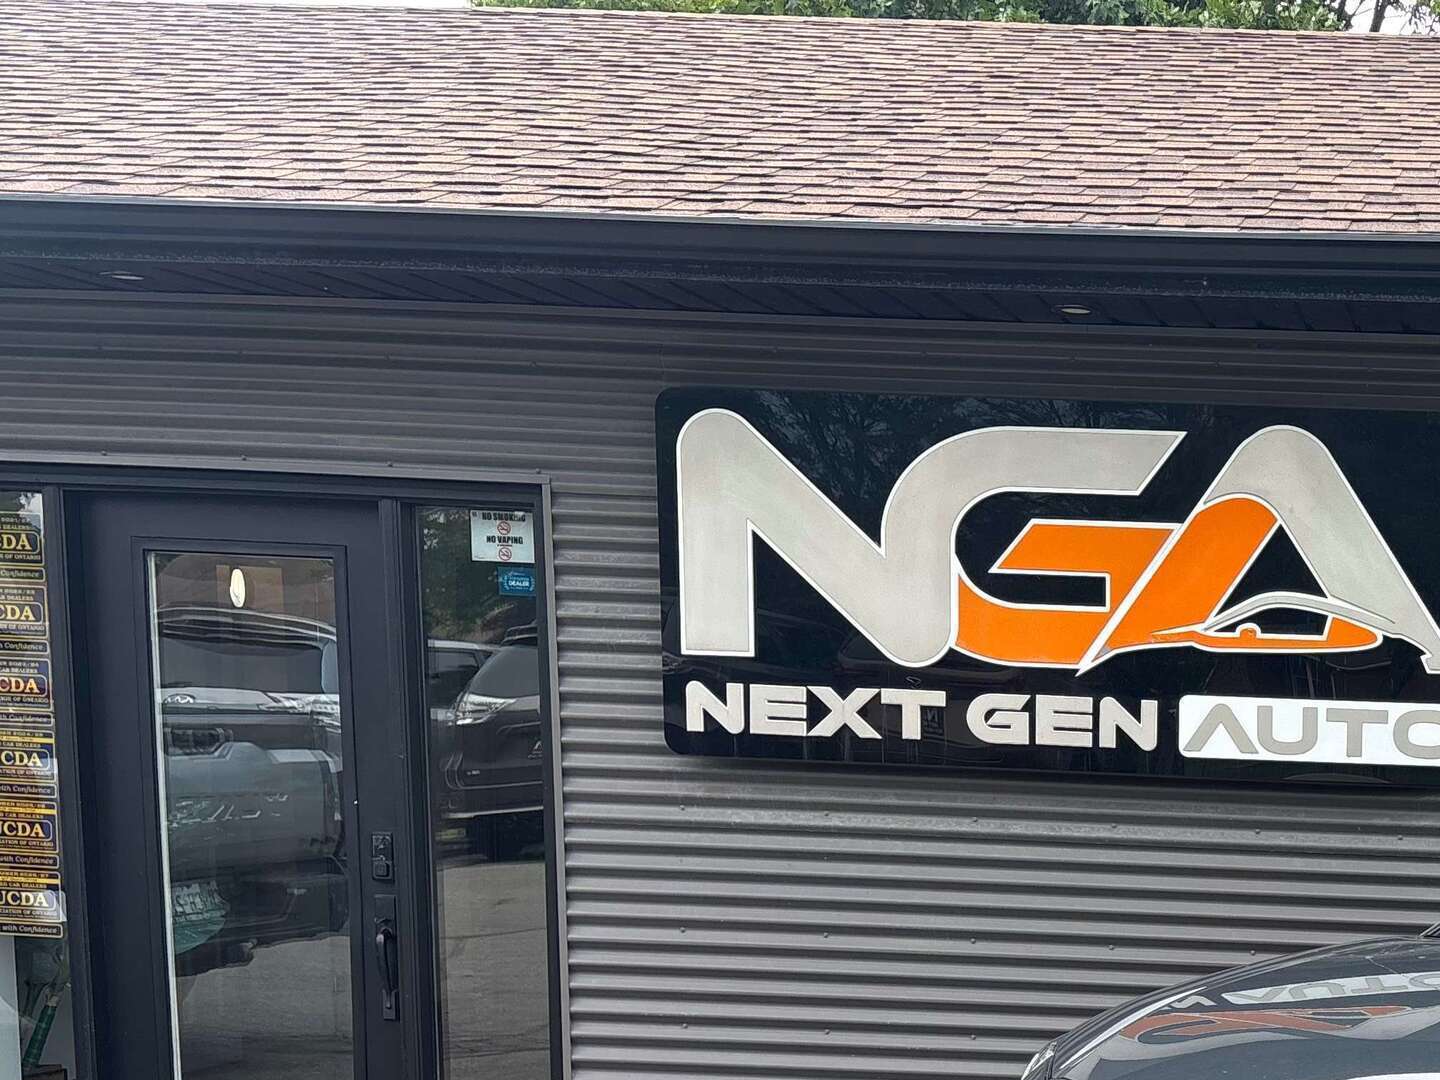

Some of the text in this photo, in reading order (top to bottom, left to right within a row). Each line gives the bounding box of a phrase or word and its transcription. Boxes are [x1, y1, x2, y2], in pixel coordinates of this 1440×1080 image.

[482, 512, 491, 520] NO
[0, 533, 32, 550] DA
[486, 535, 523, 544] NO VAPING
[685, 681, 946, 740] NEXT
[966, 693, 1157, 750] GEN
[0, 821, 46, 837] CDA
